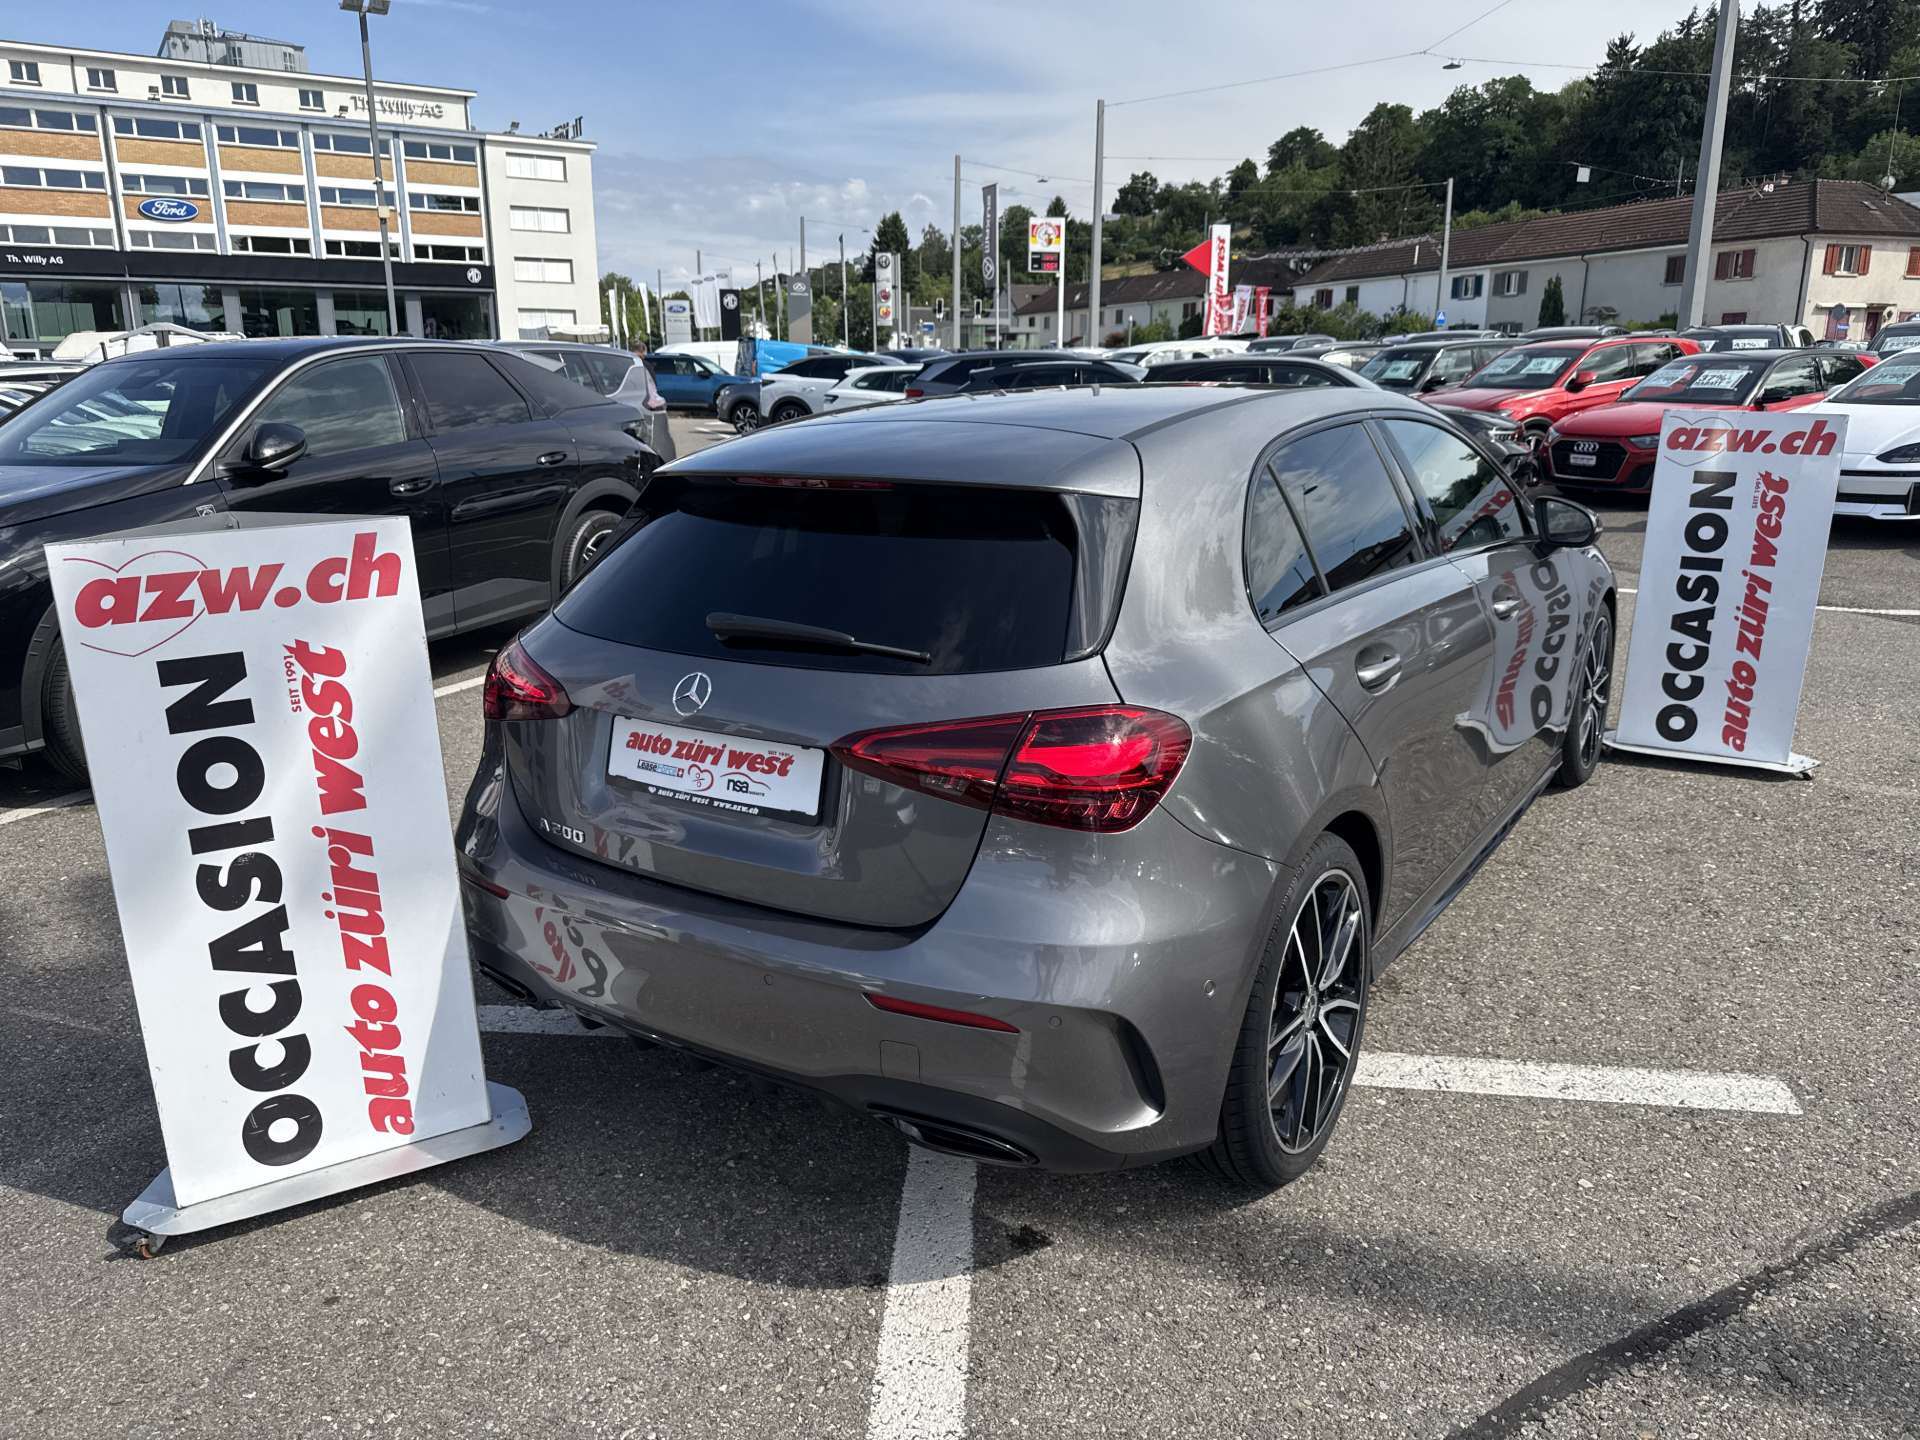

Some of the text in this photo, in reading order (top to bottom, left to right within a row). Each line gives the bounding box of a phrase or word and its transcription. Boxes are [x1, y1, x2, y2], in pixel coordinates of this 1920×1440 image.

[5, 254, 64, 266] Th. Willy AG
[1666, 420, 1837, 456] azw.ch
[74, 532, 402, 629] azw.ch
[1656, 470, 1737, 742] OCCASION
[1722, 470, 1789, 752] auto züri west
[283, 655, 302, 713] SEIT 1991
[626, 731, 795, 777] auto züri west
[657, 789, 674, 798] auto
[674, 791, 691, 801] züri
[692, 796, 710, 806] west
[727, 778, 749, 794] nsa
[156, 651, 323, 1167] OCCASION
[283, 638, 415, 1136] auto züri west
